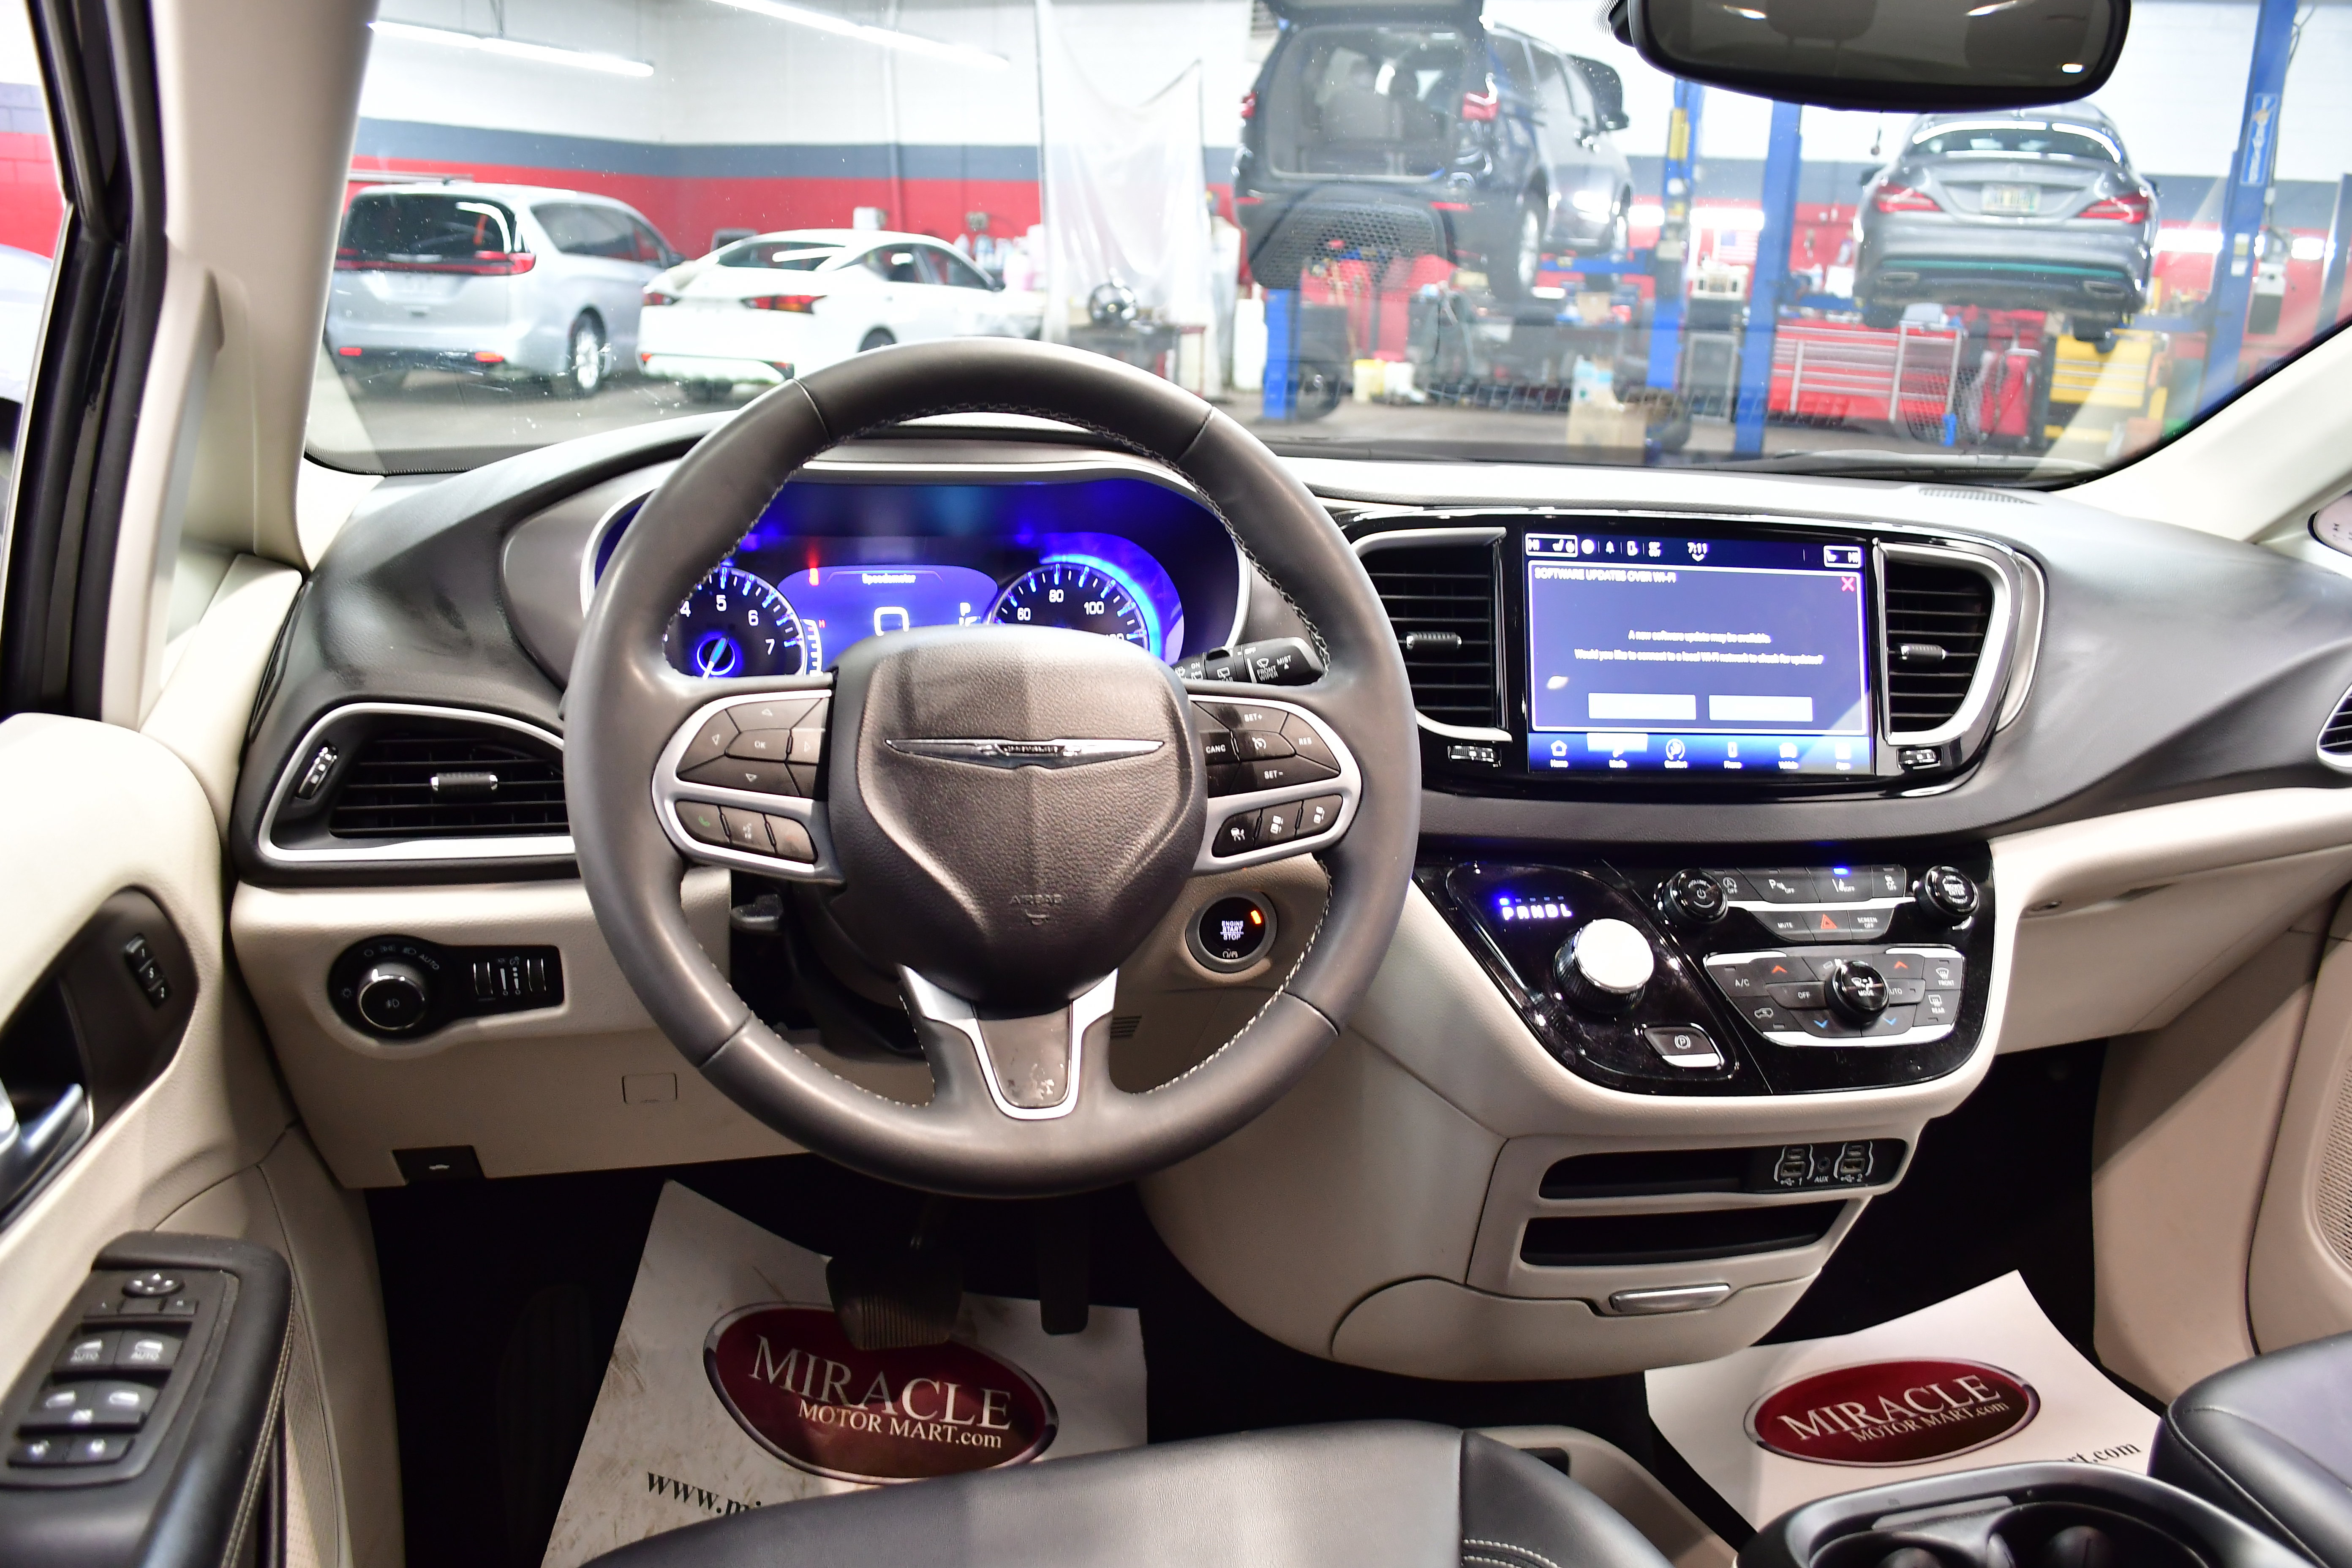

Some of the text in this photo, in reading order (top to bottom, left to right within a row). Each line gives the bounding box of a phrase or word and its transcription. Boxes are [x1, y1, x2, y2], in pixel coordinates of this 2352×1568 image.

[1535, 567, 1584, 580] SOFTWARE
[1586, 569, 1626, 582] UPDATES
[1627, 570, 1652, 583] OVER
[716, 594, 727, 611] 5
[1049, 589, 1064, 602] 80
[680, 601, 691, 617] 4
[960, 602, 971, 616] P
[1018, 607, 1031, 621] 60
[1084, 601, 1104, 615] 100
[748, 610, 759, 626] 6
[765, 639, 775, 655] 7
[1277, 655, 1291, 666] MIST
[754, 740, 766, 749] OK
[1206, 745, 1226, 754] CANC
[419, 954, 439, 970] AUTO
[1735, 978, 1750, 987] A/C
[1798, 991, 1810, 999] OFF
[749, 1334, 1012, 1430] MIRACLE
[1777, 1375, 2001, 1441] MIRACLE
[799, 1399, 1002, 1448] MOTOR MART.com
[1850, 1402, 2009, 1442] MOTOR MART.com
